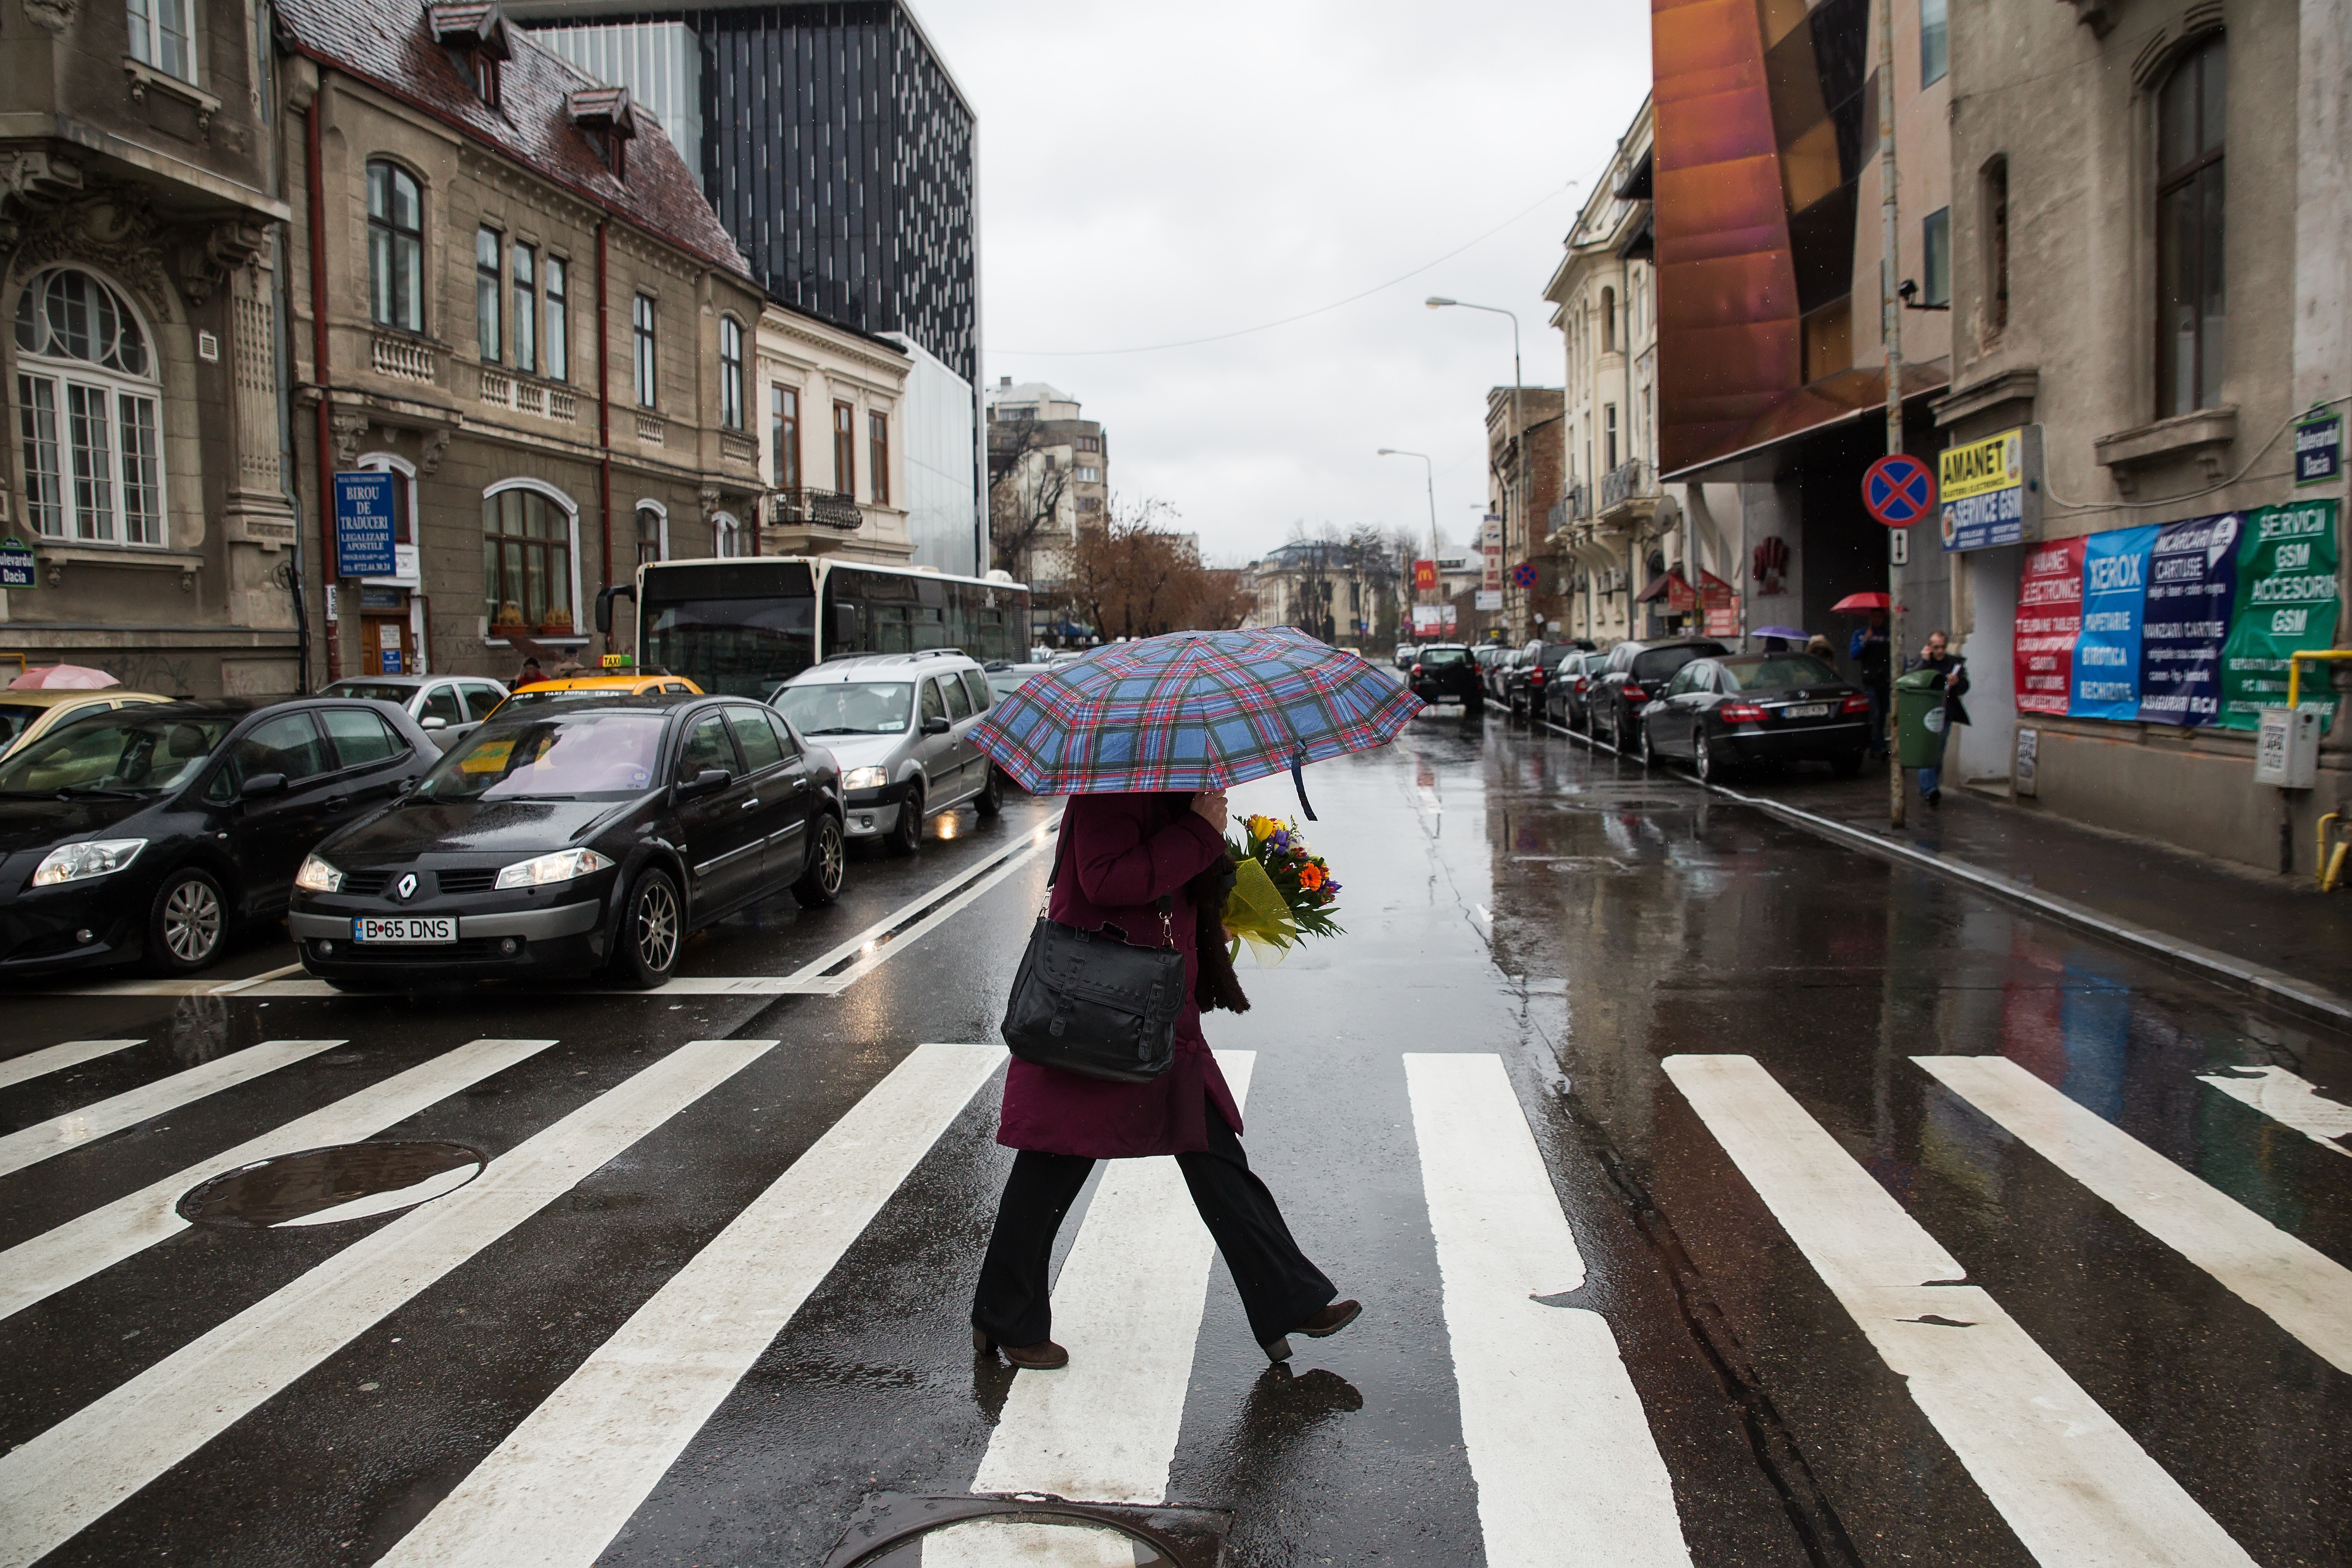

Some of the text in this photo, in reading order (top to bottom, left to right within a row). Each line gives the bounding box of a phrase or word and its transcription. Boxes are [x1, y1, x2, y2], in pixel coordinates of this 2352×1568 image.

[2296, 423, 2339, 453] Bulevardul
[1942, 440, 2004, 486] AMANET
[2303, 452, 2330, 476] Dacia
[346, 486, 379, 500] BIROU
[356, 501, 371, 515] DE
[1956, 487, 2022, 528] SERVICE GSM
[340, 515, 388, 530] TRADUCERI
[2259, 508, 2326, 538] SERVICII
[341, 533, 389, 542] LEGALIZARI
[346, 541, 384, 551] APOSTILE
[0, 551, 34, 567] ulevardul
[2032, 548, 2069, 572] AMANET
[2275, 543, 2311, 568] GSM
[3, 568, 27, 583] Dacia
[2089, 553, 2141, 590] XEROX
[2155, 557, 2204, 580] CARTUSE
[2271, 608, 2308, 632] GSM
[604, 657, 620, 666] TAXI
[2082, 647, 2127, 666] BIROTICA
[366, 920, 449, 938] B 65 DNS
